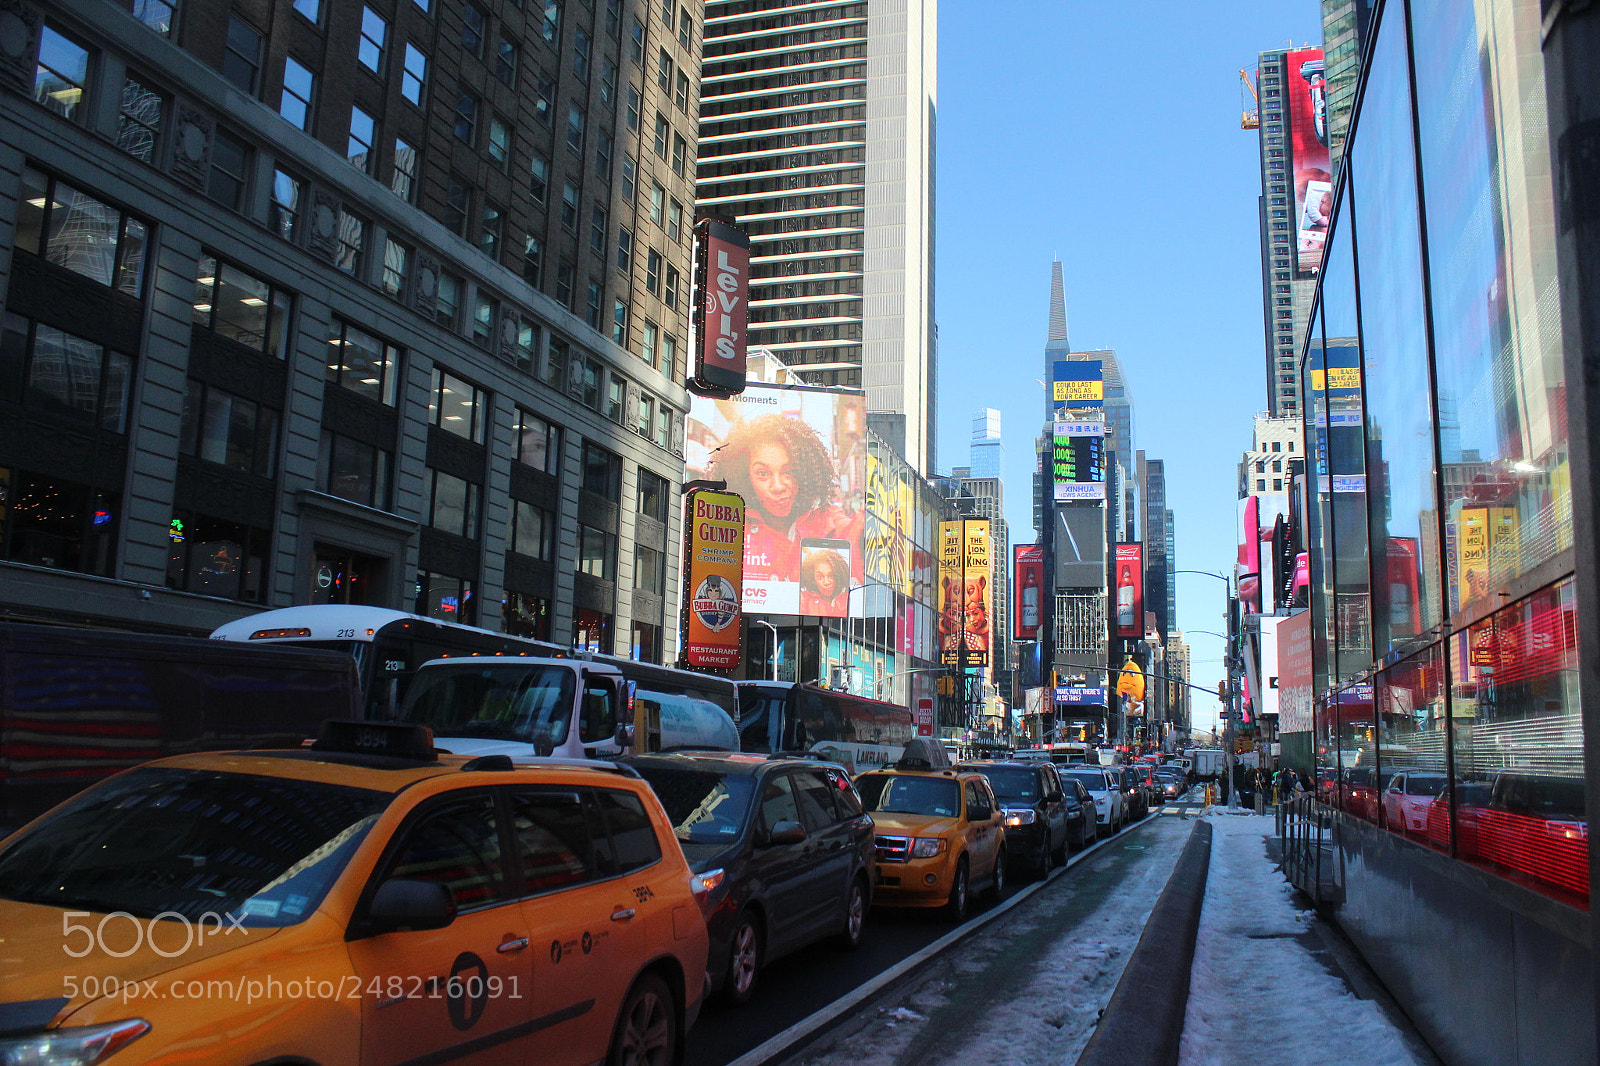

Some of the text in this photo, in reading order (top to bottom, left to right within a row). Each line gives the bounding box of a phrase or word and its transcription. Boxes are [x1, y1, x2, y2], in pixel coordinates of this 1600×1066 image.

[732, 394, 778, 405] Moments
[1065, 485, 1096, 493] XINHUA
[696, 498, 742, 523] BUBBA
[698, 522, 738, 544] GUMP
[701, 547, 735, 557] SHRIMP
[967, 544, 986, 555] LION
[696, 554, 738, 565] COMPANY
[966, 555, 988, 568] KING
[744, 587, 768, 598] CVS
[694, 600, 718, 611] BUBBA
[718, 601, 739, 615] GUMP
[336, 628, 355, 638] 213
[690, 645, 738, 655] RESTAURANT
[698, 655, 730, 664] MARKET
[385, 660, 398, 671] 213
[855, 748, 889, 765] LAKELAND
